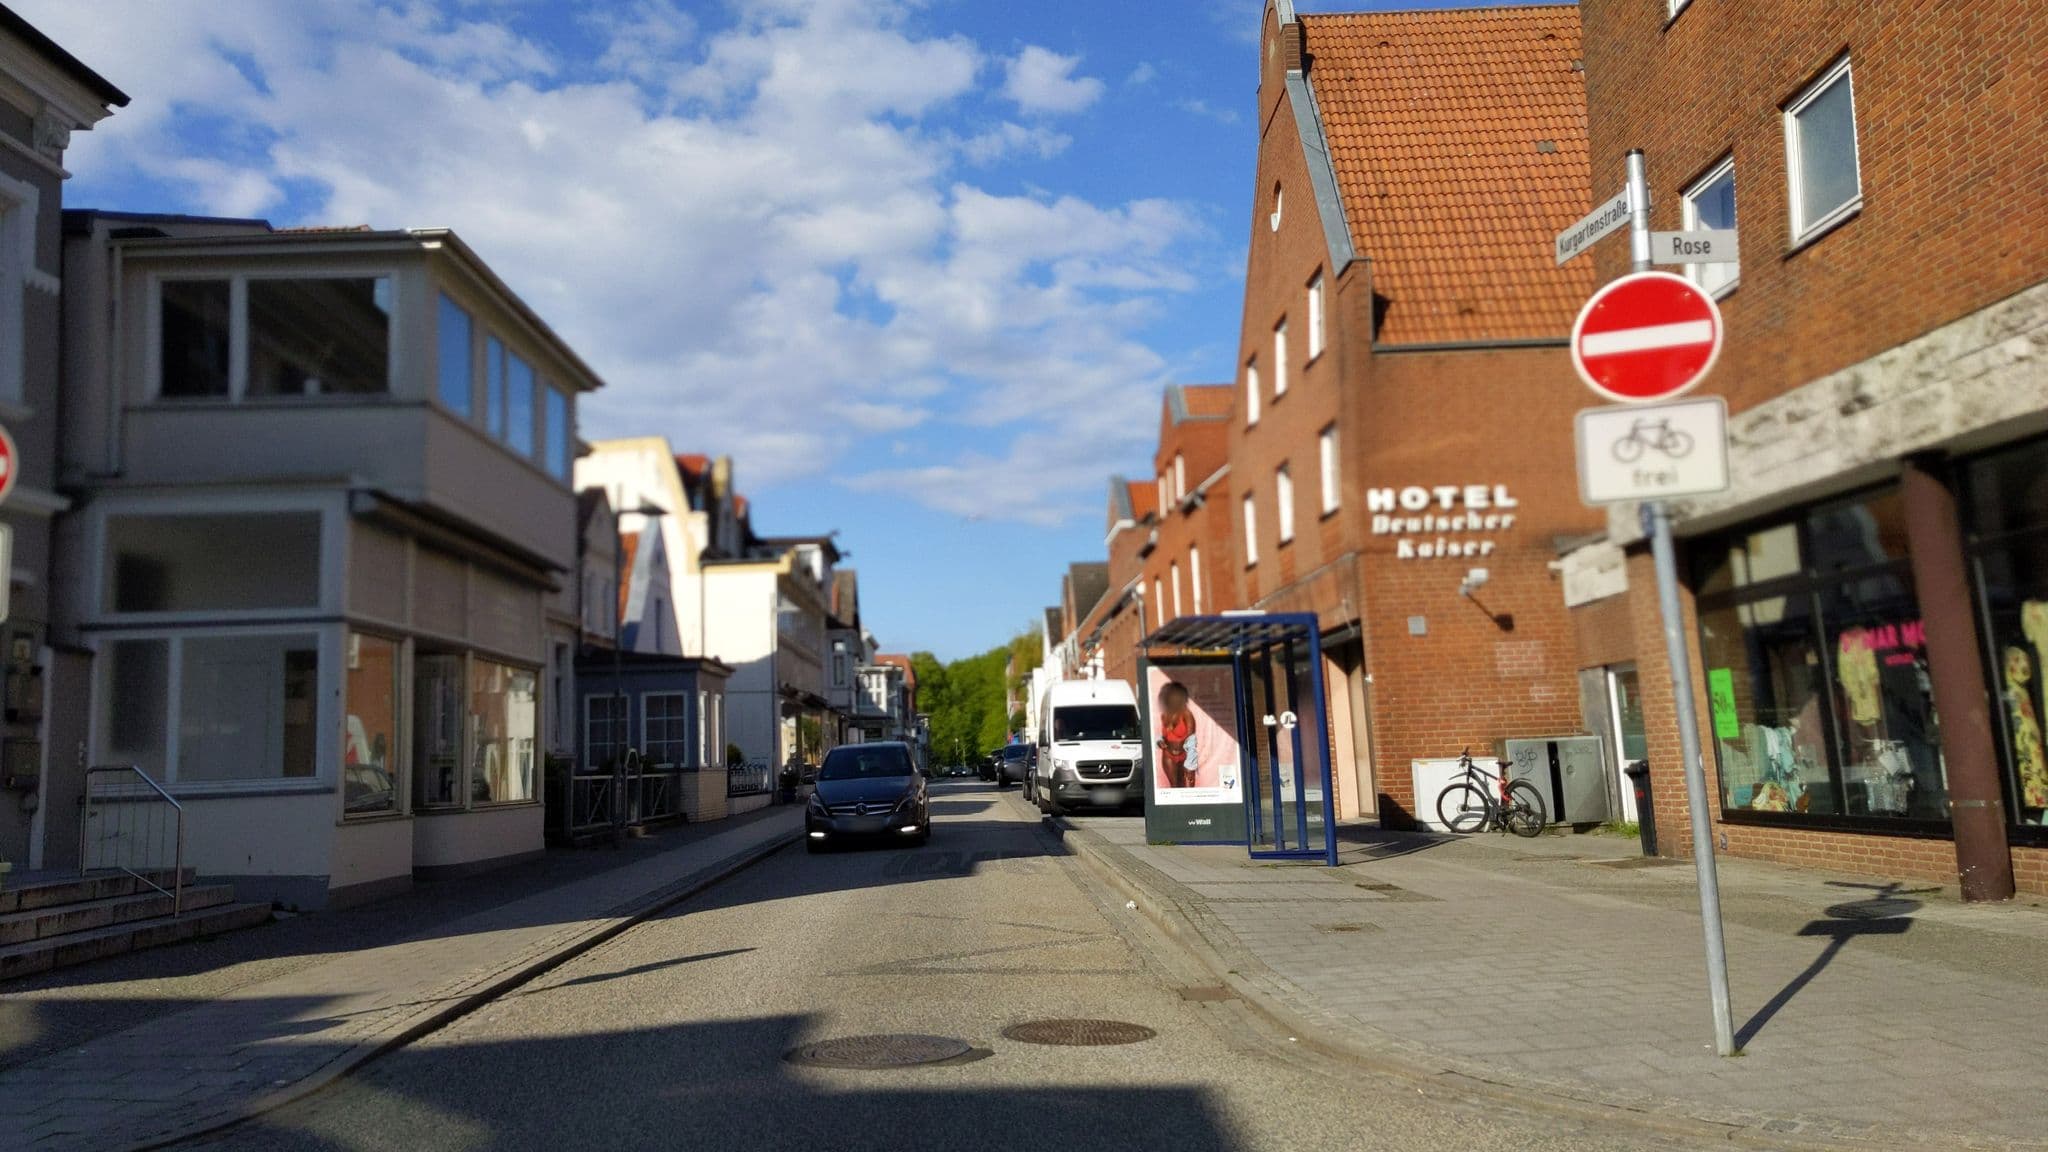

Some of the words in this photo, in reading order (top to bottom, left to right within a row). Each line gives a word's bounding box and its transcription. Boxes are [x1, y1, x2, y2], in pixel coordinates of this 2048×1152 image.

[1559, 199, 1627, 254] Kurgartenstraße
[1673, 237, 1711, 255] Rose
[1366, 484, 1518, 512] HOTEL
[1372, 510, 1516, 535] Deutscher
[1397, 537, 1495, 559] Kaiser
